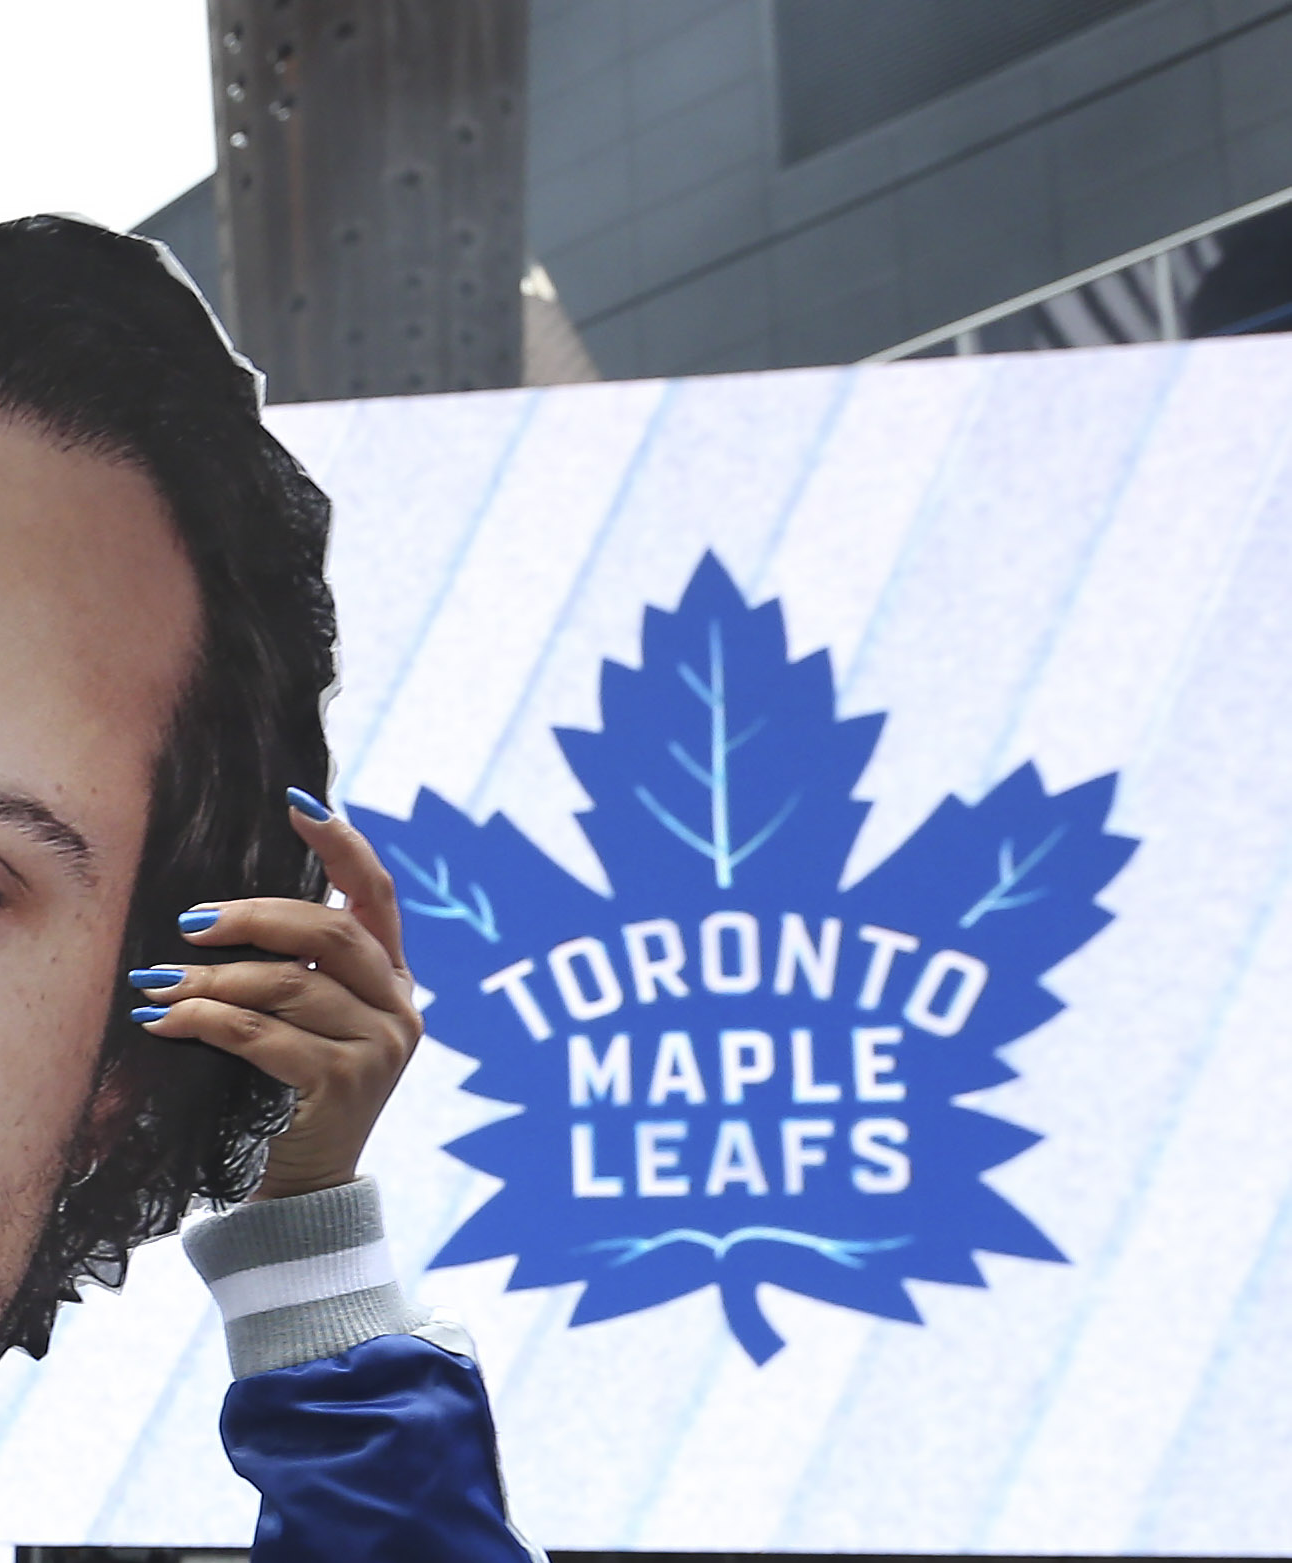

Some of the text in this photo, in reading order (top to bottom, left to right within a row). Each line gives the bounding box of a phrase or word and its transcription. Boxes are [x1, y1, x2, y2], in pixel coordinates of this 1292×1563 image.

[480, 910, 990, 1041] TORONTO
[567, 1026, 907, 1108] MAPLE
[570, 1117, 912, 1199] LEAFS
